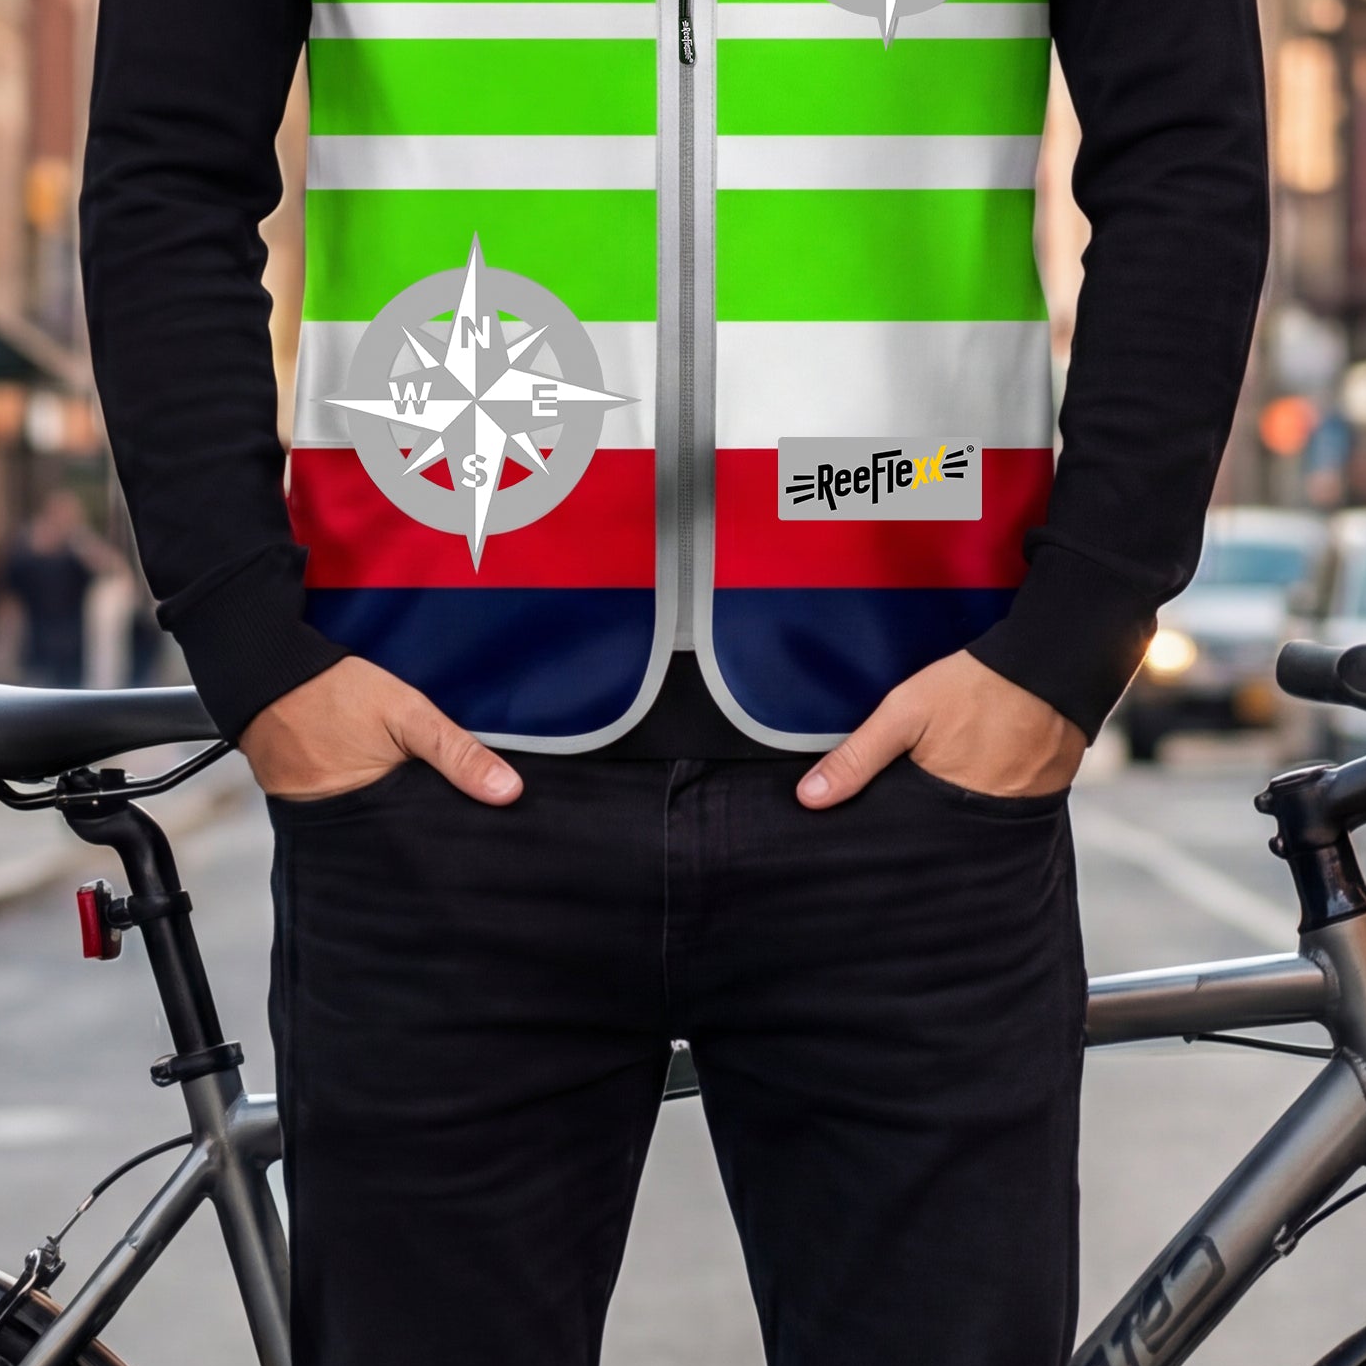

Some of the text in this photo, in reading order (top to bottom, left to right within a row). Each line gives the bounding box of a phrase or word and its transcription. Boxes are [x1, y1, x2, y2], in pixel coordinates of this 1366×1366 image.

[460, 315, 491, 349] N
[387, 381, 432, 415] W
[531, 383, 558, 417] E
[460, 453, 488, 488] S
